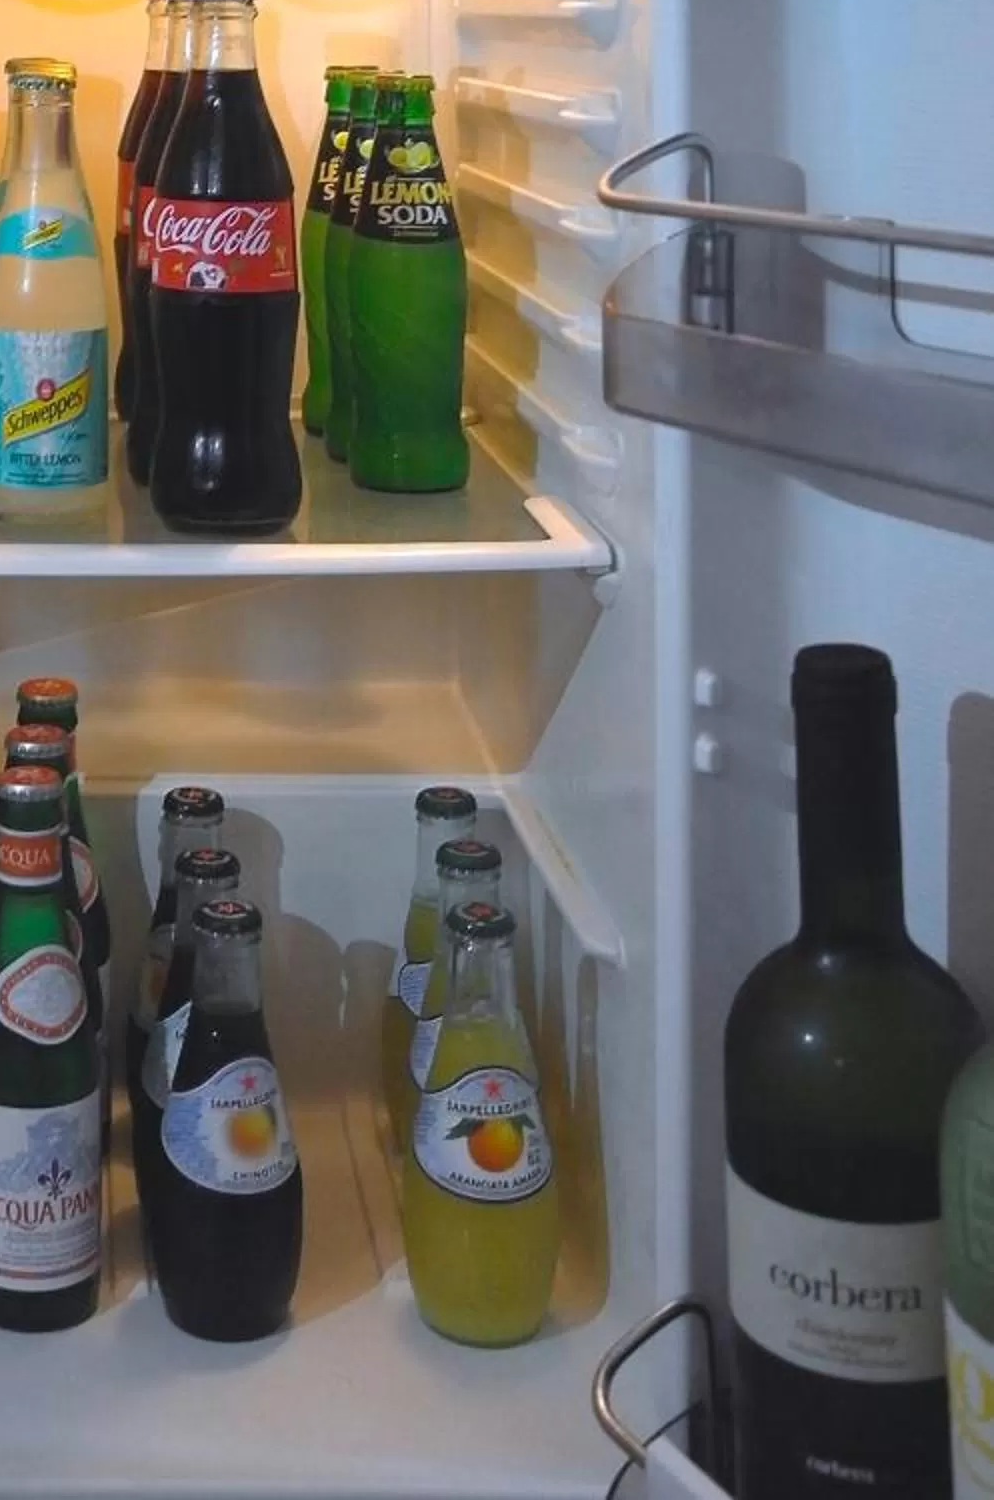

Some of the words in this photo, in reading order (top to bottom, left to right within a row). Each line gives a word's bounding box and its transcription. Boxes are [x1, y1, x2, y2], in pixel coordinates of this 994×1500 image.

[370, 180, 453, 206] LEMON
[156, 203, 279, 257] Coca-Cola
[377, 205, 448, 225] SODA
[7, 386, 83, 437] Schweppes
[0, 844, 53, 872] CQUA
[61, 1182, 99, 1221] PAN
[769, 1263, 924, 1313] corbera
